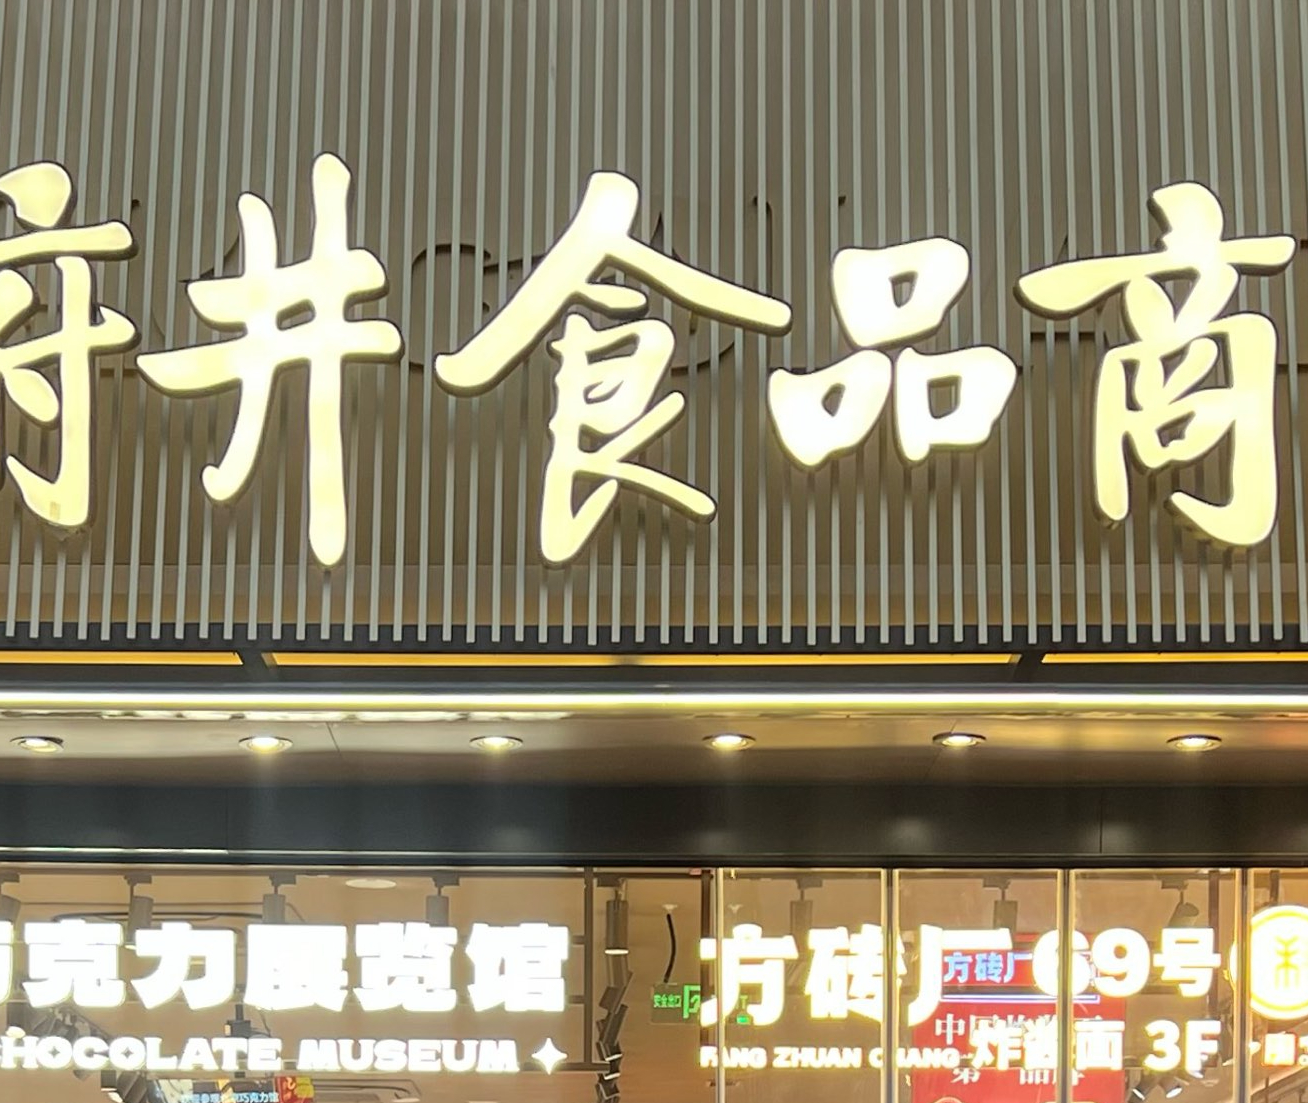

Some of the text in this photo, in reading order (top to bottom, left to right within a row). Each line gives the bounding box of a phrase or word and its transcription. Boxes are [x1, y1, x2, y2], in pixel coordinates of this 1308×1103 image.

[297, 1039, 520, 1072] MUSEUM
[772, 1046, 862, 1068] ZHUAN
[1144, 1019, 1221, 1072] 3F
